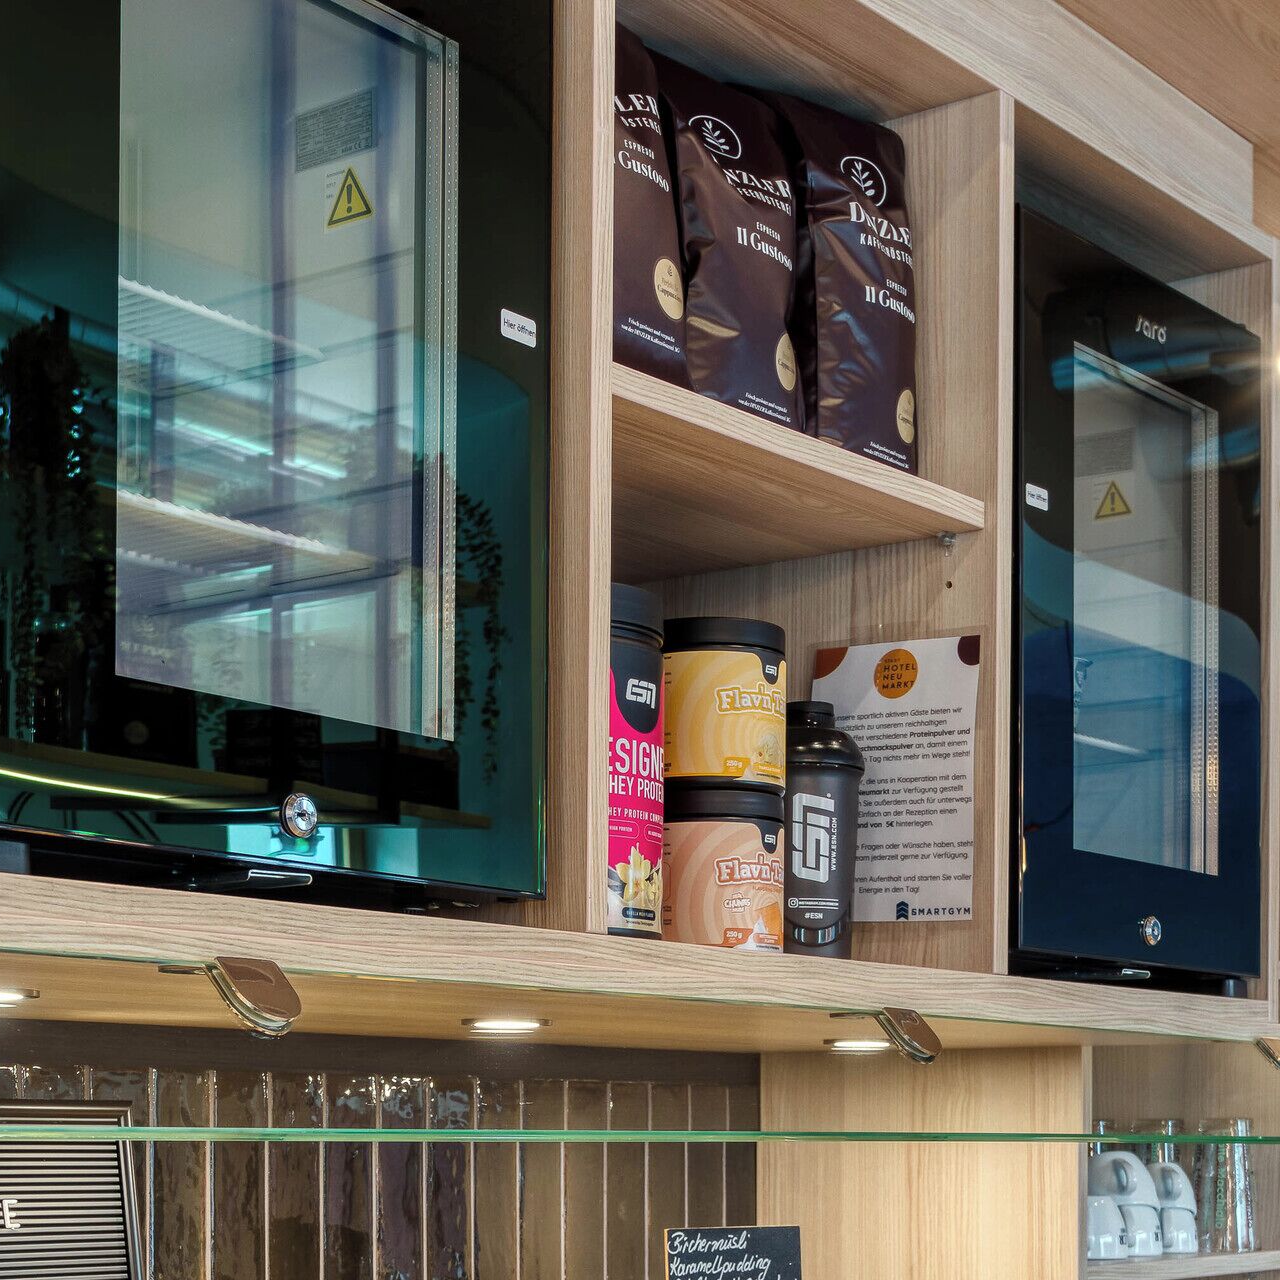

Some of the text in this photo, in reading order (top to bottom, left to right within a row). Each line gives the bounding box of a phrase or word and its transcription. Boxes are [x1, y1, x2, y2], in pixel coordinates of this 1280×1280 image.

[618, 150, 670, 193] Gustoso
[750, 232, 793, 272] Gustoso
[879, 289, 916, 324] Gustoso
[883, 663, 916, 672] HOTEL
[882, 673, 903, 681] NEU
[882, 680, 916, 690] MARKT
[857, 711, 884, 722] sportlich
[885, 710, 909, 719] aktiven
[910, 708, 929, 717] Gäste
[930, 707, 951, 716] bieten
[952, 706, 963, 714] wir
[875, 721, 904, 730] unserem
[905, 718, 947, 729] reichhaltigen
[866, 727, 971, 741] verschiedene Proteinpulver und
[926, 741, 947, 749] damit
[947, 740, 968, 748] einem
[608, 737, 665, 783] SIGNE
[868, 755, 882, 763] Tag
[883, 754, 902, 762] nichts
[903, 753, 920, 761] mehr
[921, 752, 930, 760] im
[931, 751, 951, 761] Wege
[897, 774, 938, 785] Kooperation
[951, 773, 967, 781] dem
[609, 774, 634, 796] HEY
[903, 786, 938, 795] Verfügung
[939, 784, 964, 794] gestellt
[863, 796, 972, 807] Sie außerdem auch für unterwegs
[608, 806, 621, 816] HEY
[892, 809, 904, 817] der
[905, 808, 938, 817] Rezeption
[939, 807, 958, 815] einen
[830, 816, 838, 871] WWW.ESN.COM
[860, 843, 884, 852] Fragen
[885, 842, 901, 850] oder
[901, 841, 932, 849] Wünsche
[870, 853, 899, 862] jederzeit
[899, 853, 920, 862] gerne
[869, 875, 902, 883] Aufenthalt
[941, 873, 952, 881] Sie
[952, 873, 972, 881] voller
[858, 886, 883, 895] Energie
[891, 885, 904, 893] den
[804, 912, 823, 920] #ESN
[911, 907, 971, 916] SMARTGYM
[667, 1231, 751, 1255] Birchermüsli
